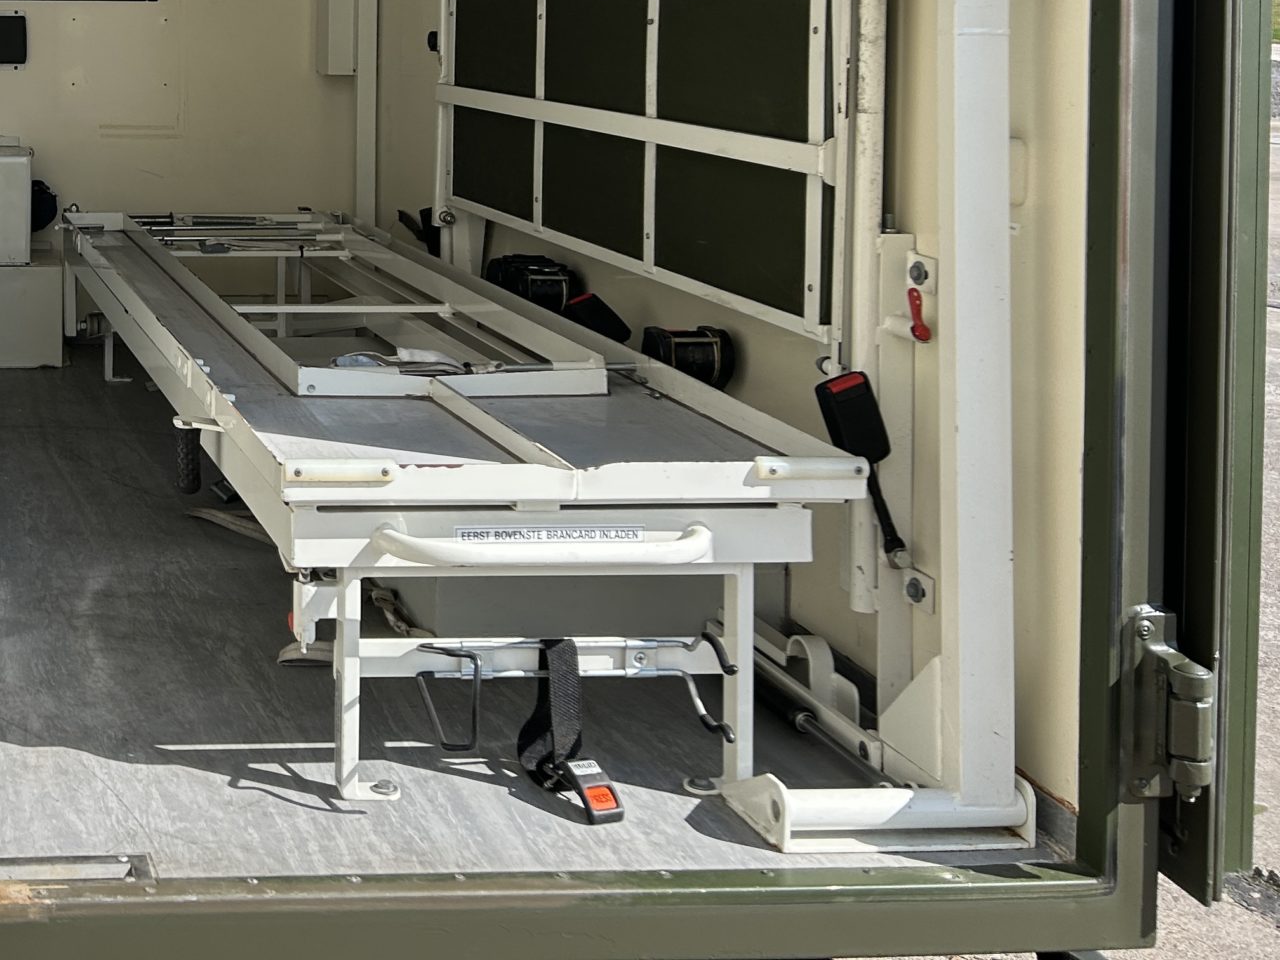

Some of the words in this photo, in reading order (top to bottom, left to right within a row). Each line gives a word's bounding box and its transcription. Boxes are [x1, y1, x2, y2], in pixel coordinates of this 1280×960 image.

[461, 530, 491, 541] EERST
[494, 529, 542, 540] BOVENSTE
[546, 529, 597, 540] BRANCARD
[598, 528, 639, 539] INLADEN
